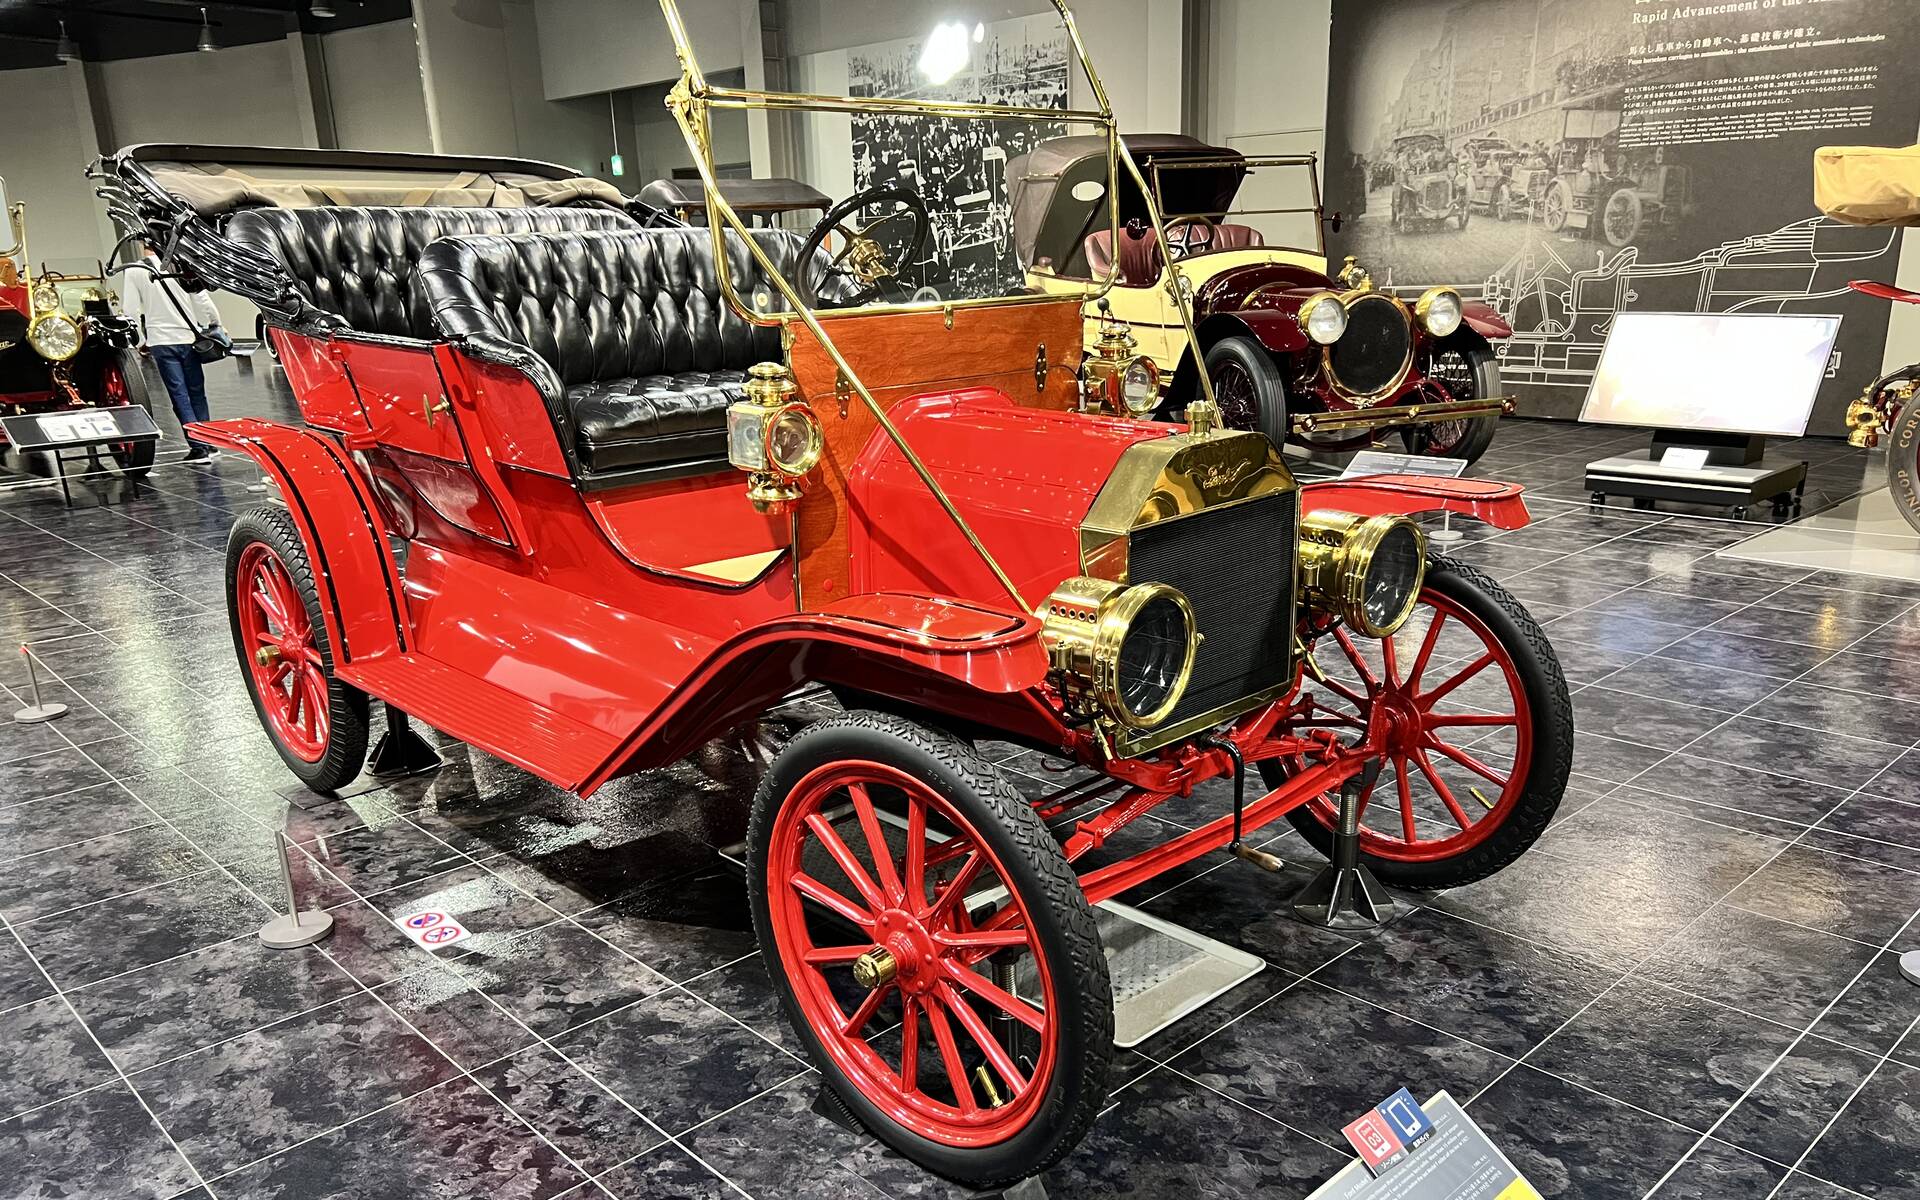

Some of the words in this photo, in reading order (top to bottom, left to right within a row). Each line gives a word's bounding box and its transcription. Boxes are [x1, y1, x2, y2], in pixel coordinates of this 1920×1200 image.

[1632, 8, 1668, 24] Rapid
[1672, 1, 1758, 20] Advancement
[1763, 0, 1776, 8] of
[1368, 1133, 1381, 1146] 03
